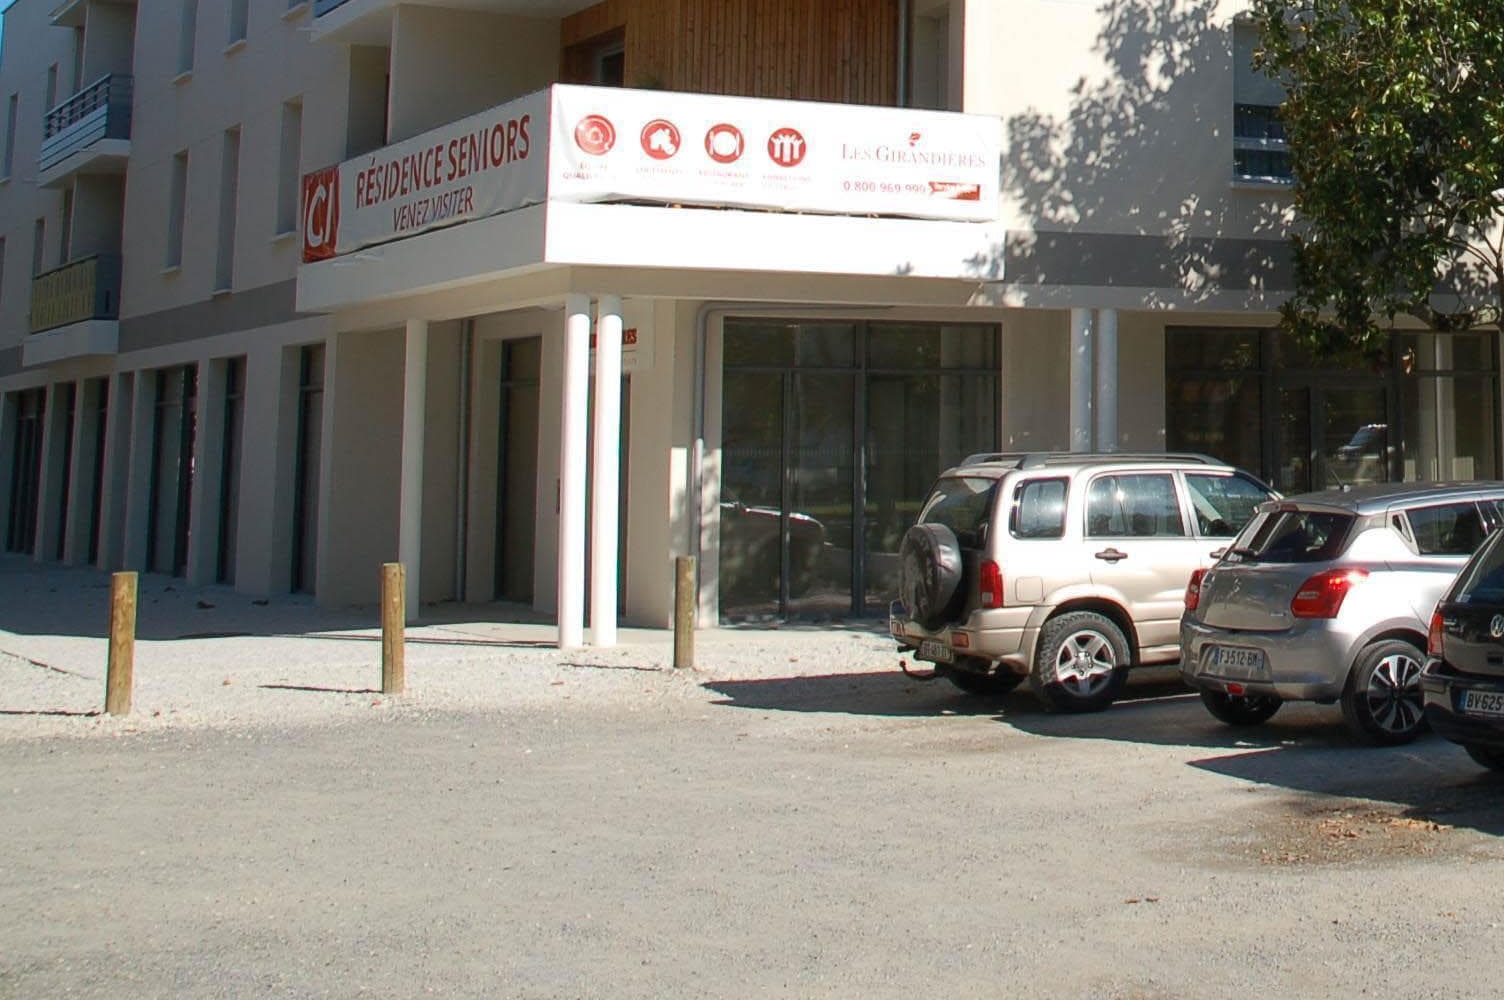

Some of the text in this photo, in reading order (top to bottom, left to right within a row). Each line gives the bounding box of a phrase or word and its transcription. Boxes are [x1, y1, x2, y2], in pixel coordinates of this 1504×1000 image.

[356, 114, 531, 209] RÉSIDENCE SENIORS
[854, 180, 876, 192] 800
[393, 184, 474, 233] VENEZ VISITER
